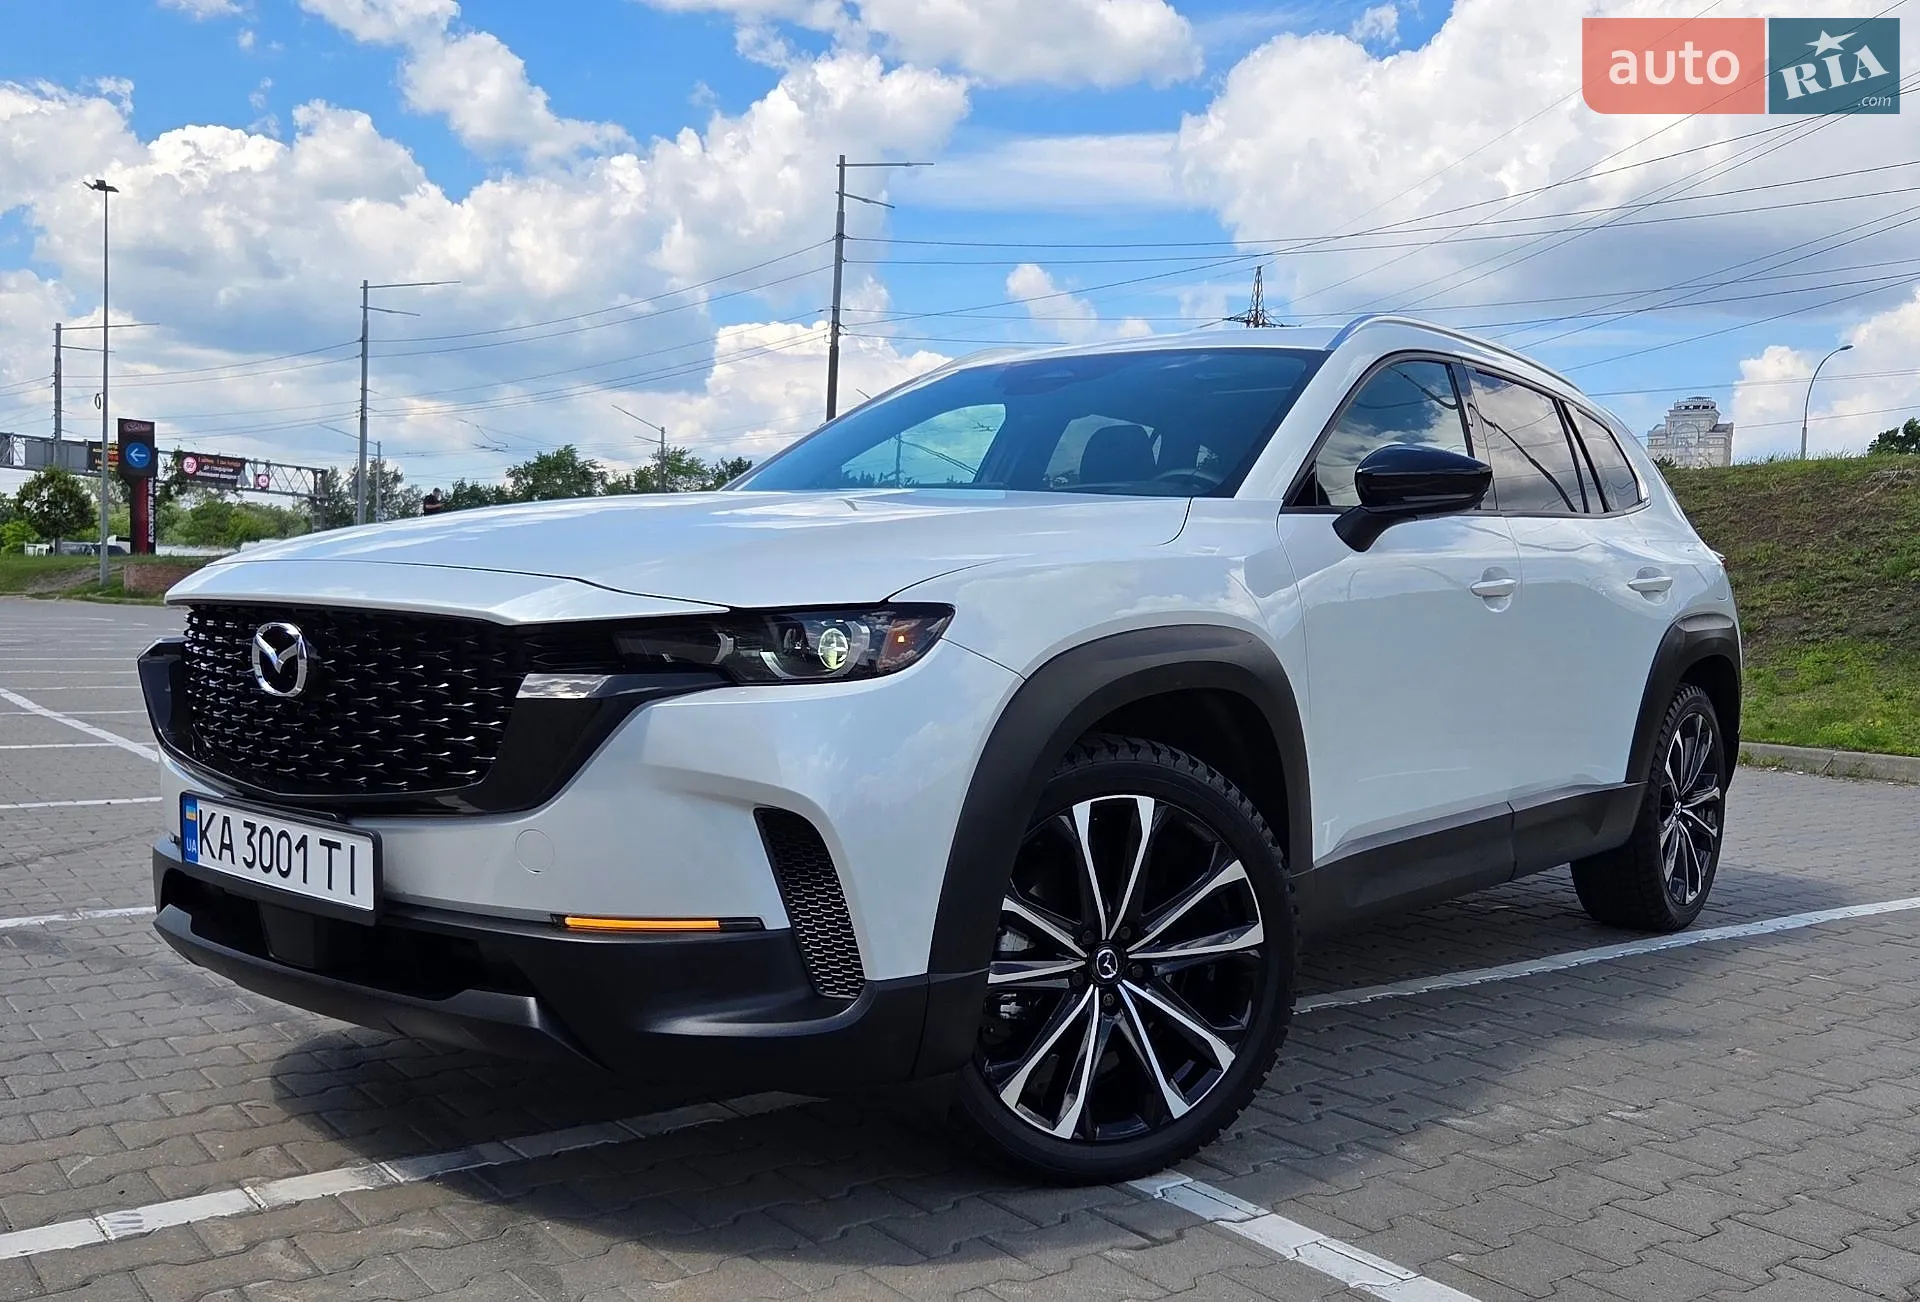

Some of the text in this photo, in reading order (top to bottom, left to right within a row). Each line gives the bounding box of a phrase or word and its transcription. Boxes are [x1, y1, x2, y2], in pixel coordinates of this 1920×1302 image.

[186, 838, 197, 853] UA
[198, 808, 356, 896] KA 3001 TI
